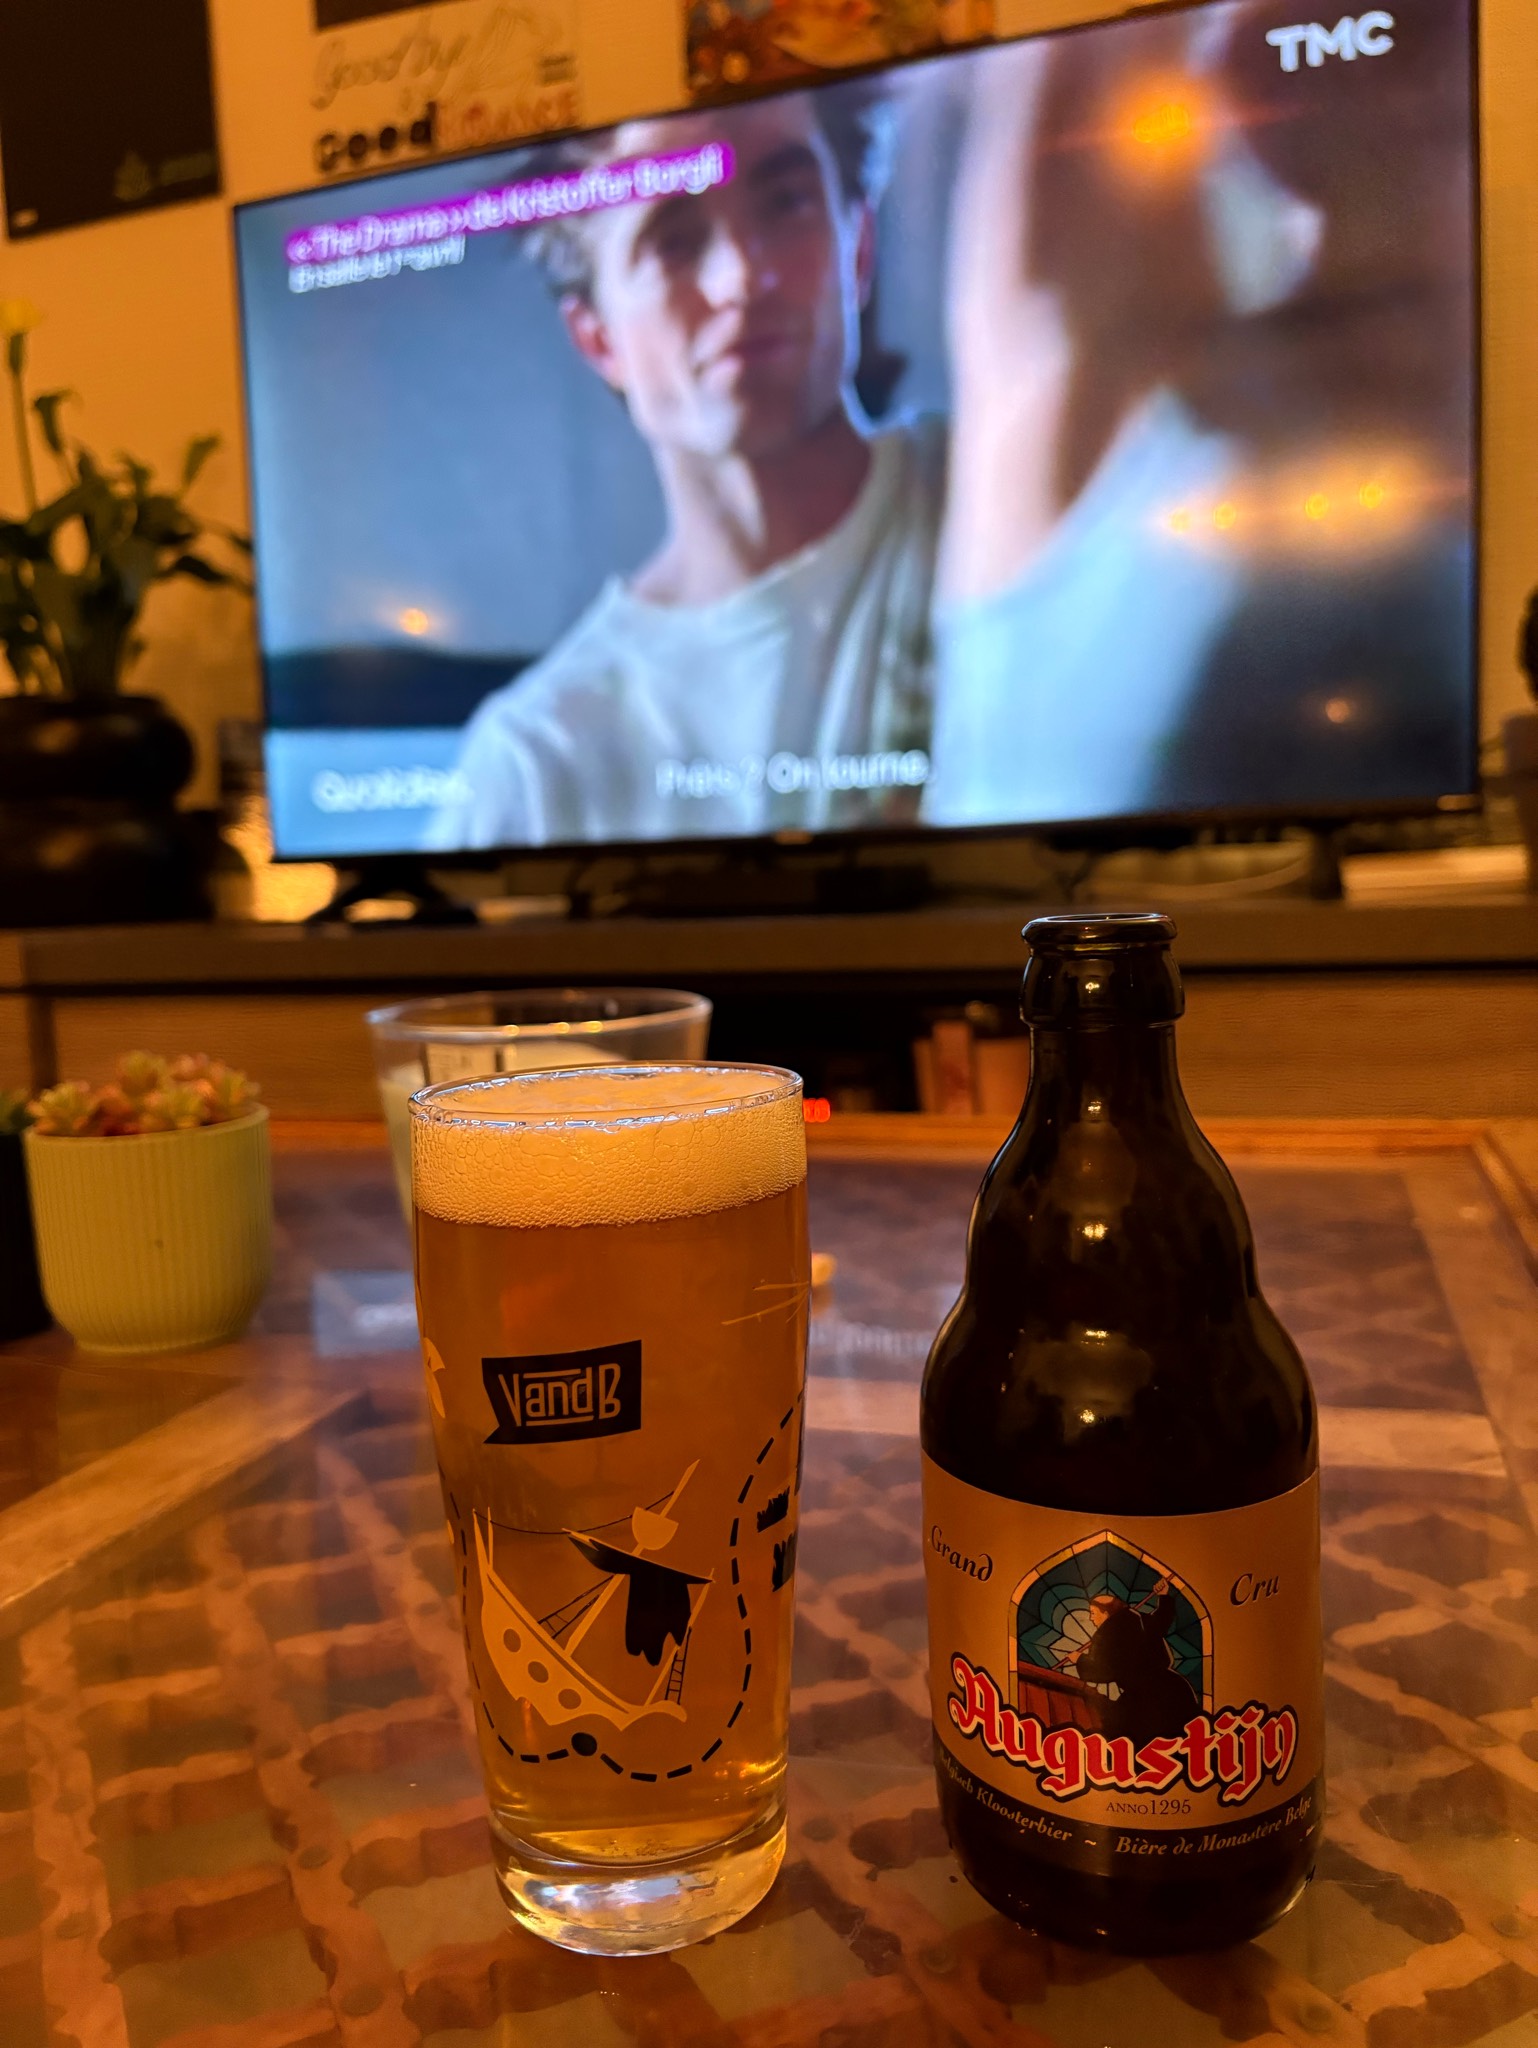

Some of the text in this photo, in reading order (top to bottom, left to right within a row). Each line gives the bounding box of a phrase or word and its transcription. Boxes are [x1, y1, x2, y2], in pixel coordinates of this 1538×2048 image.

[1265, 10, 1394, 72] TMC
[930, 1524, 994, 1582] Grand
[1229, 1572, 1280, 1607] Cru
[948, 1652, 1299, 1804] Augustijn
[976, 1787, 1073, 1841] Kloosterbier
[1114, 1835, 1169, 1855] Bière
[1172, 1836, 1194, 1855] de
[1196, 1818, 1282, 1854] Monastère
[1106, 1799, 1192, 1816] ANNO 1295
